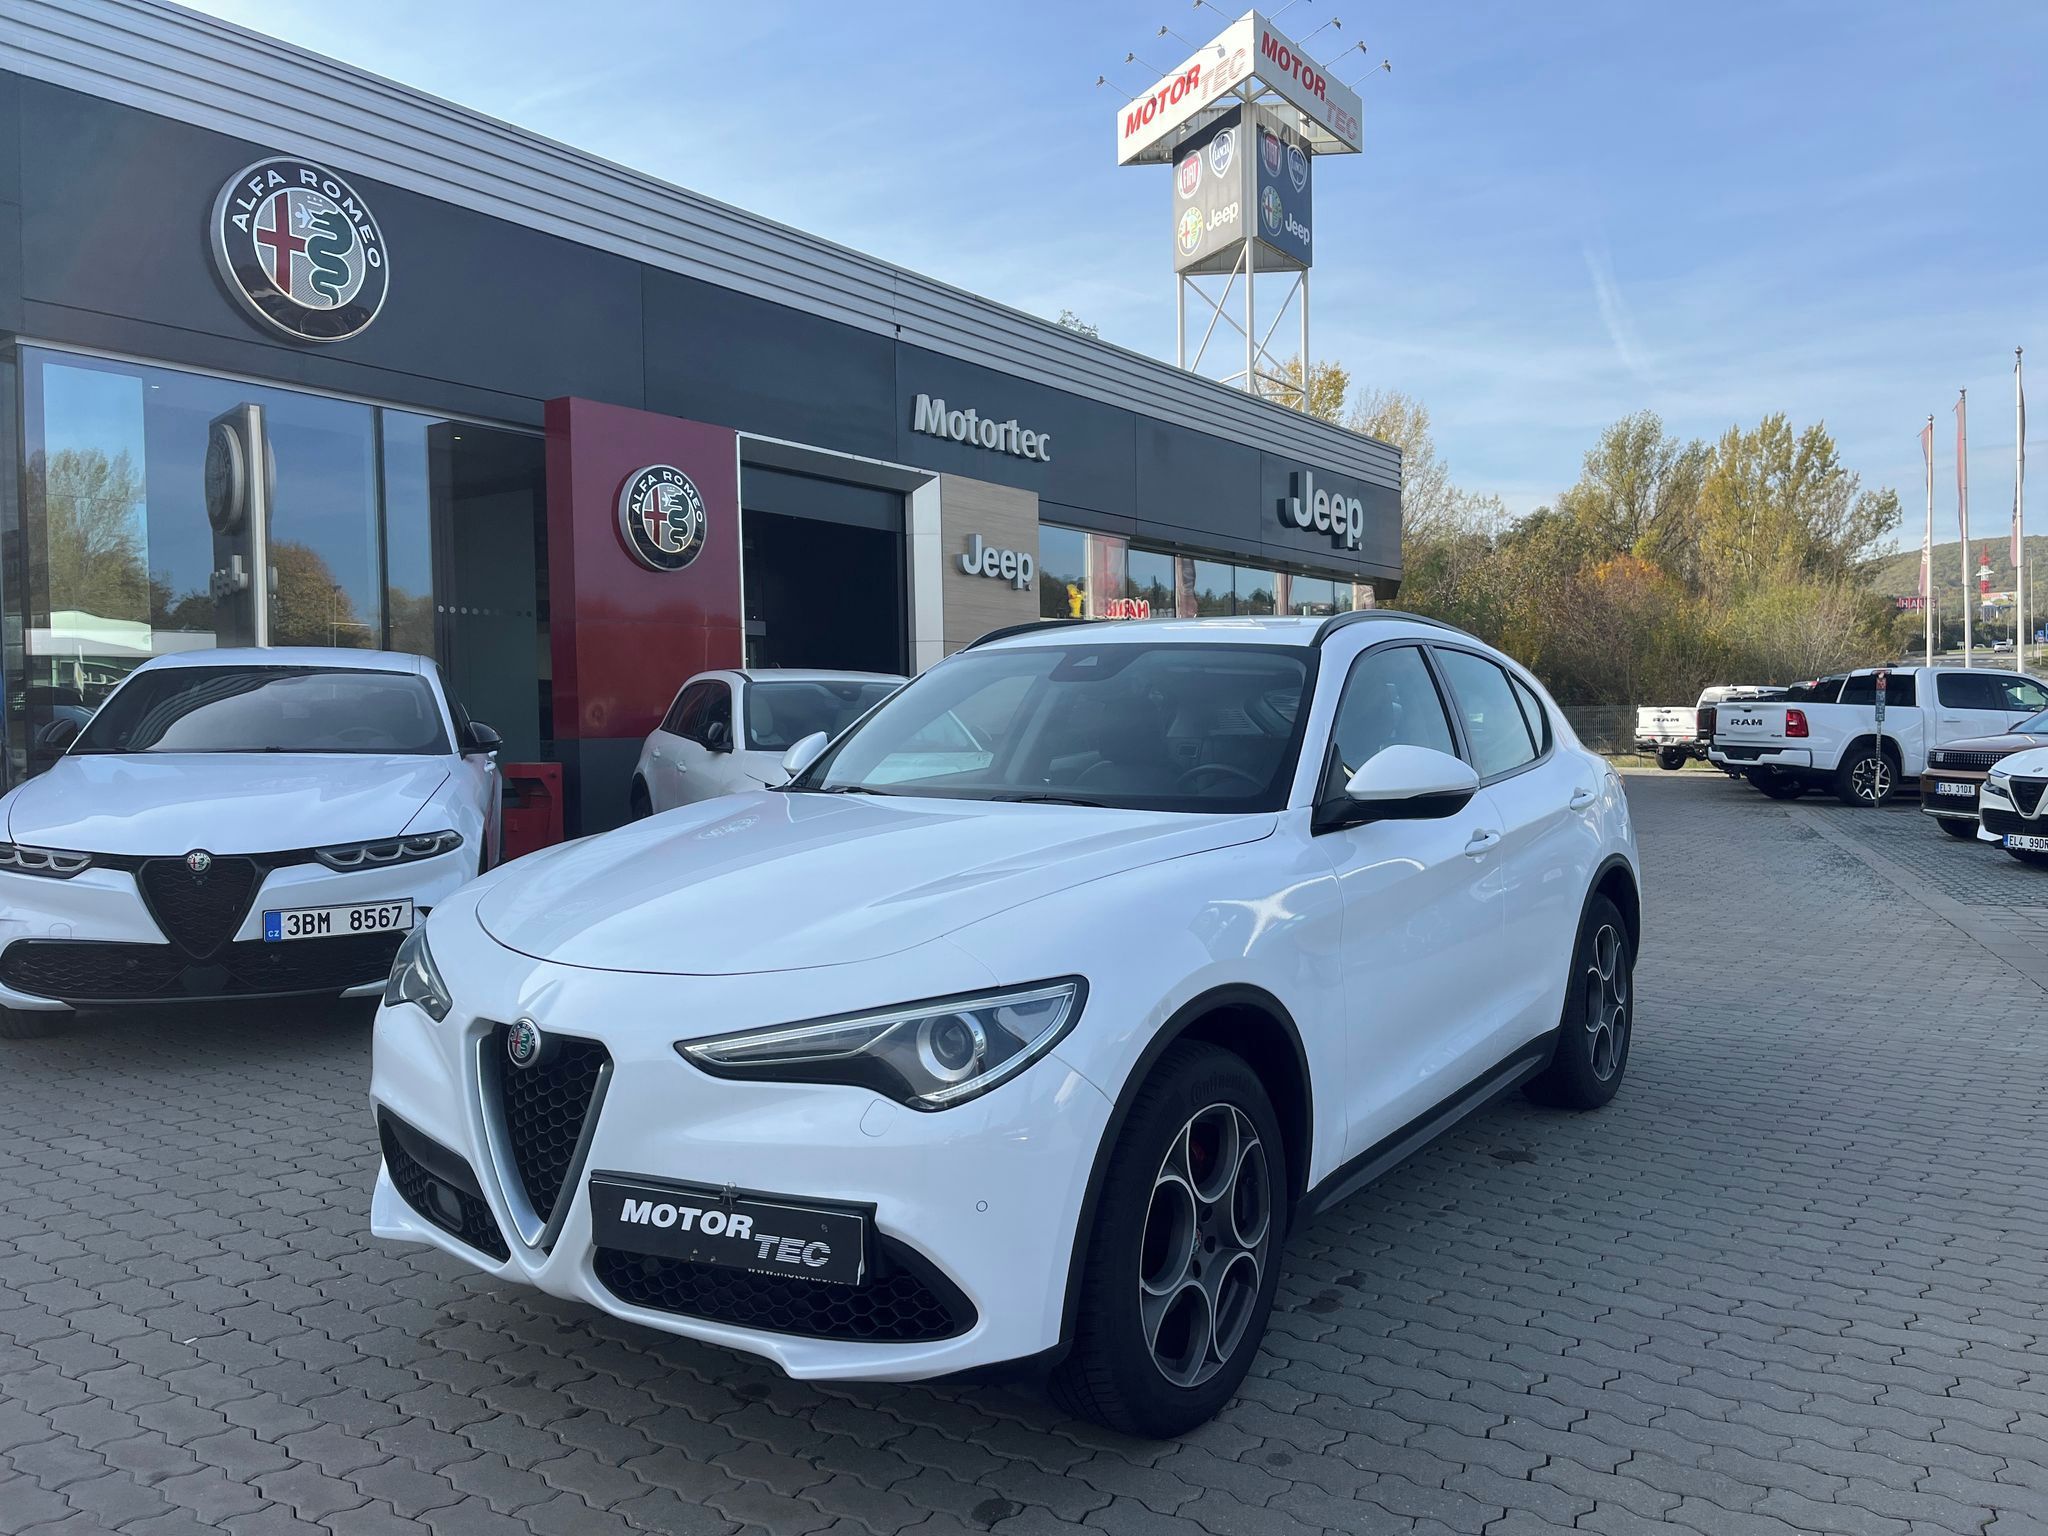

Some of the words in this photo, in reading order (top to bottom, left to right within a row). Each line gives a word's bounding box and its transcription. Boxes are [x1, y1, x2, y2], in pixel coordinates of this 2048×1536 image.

[1124, 63, 1201, 139] MOTOR
[1200, 48, 1247, 100] TEC
[1261, 30, 1326, 102] MOTOR
[1326, 98, 1359, 141] TEC
[231, 169, 286, 234] ALFA
[299, 168, 381, 268] ROMEO
[1206, 201, 1239, 232] Jeep
[1285, 212, 1310, 245] Jeep
[913, 393, 1051, 462] Motortec
[631, 474, 657, 515] ALFA
[662, 470, 703, 523] ROMEO
[1288, 470, 1364, 550] Jeep
[959, 533, 1034, 590] Jeep
[1730, 718, 1763, 726] RAM
[1940, 783, 1952, 793] EL3
[2009, 835, 2024, 847] EL4
[287, 911, 331, 936] 3BM
[350, 905, 403, 931] 8567
[620, 1198, 754, 1240] MOTOR
[754, 1234, 831, 1268] TEC
